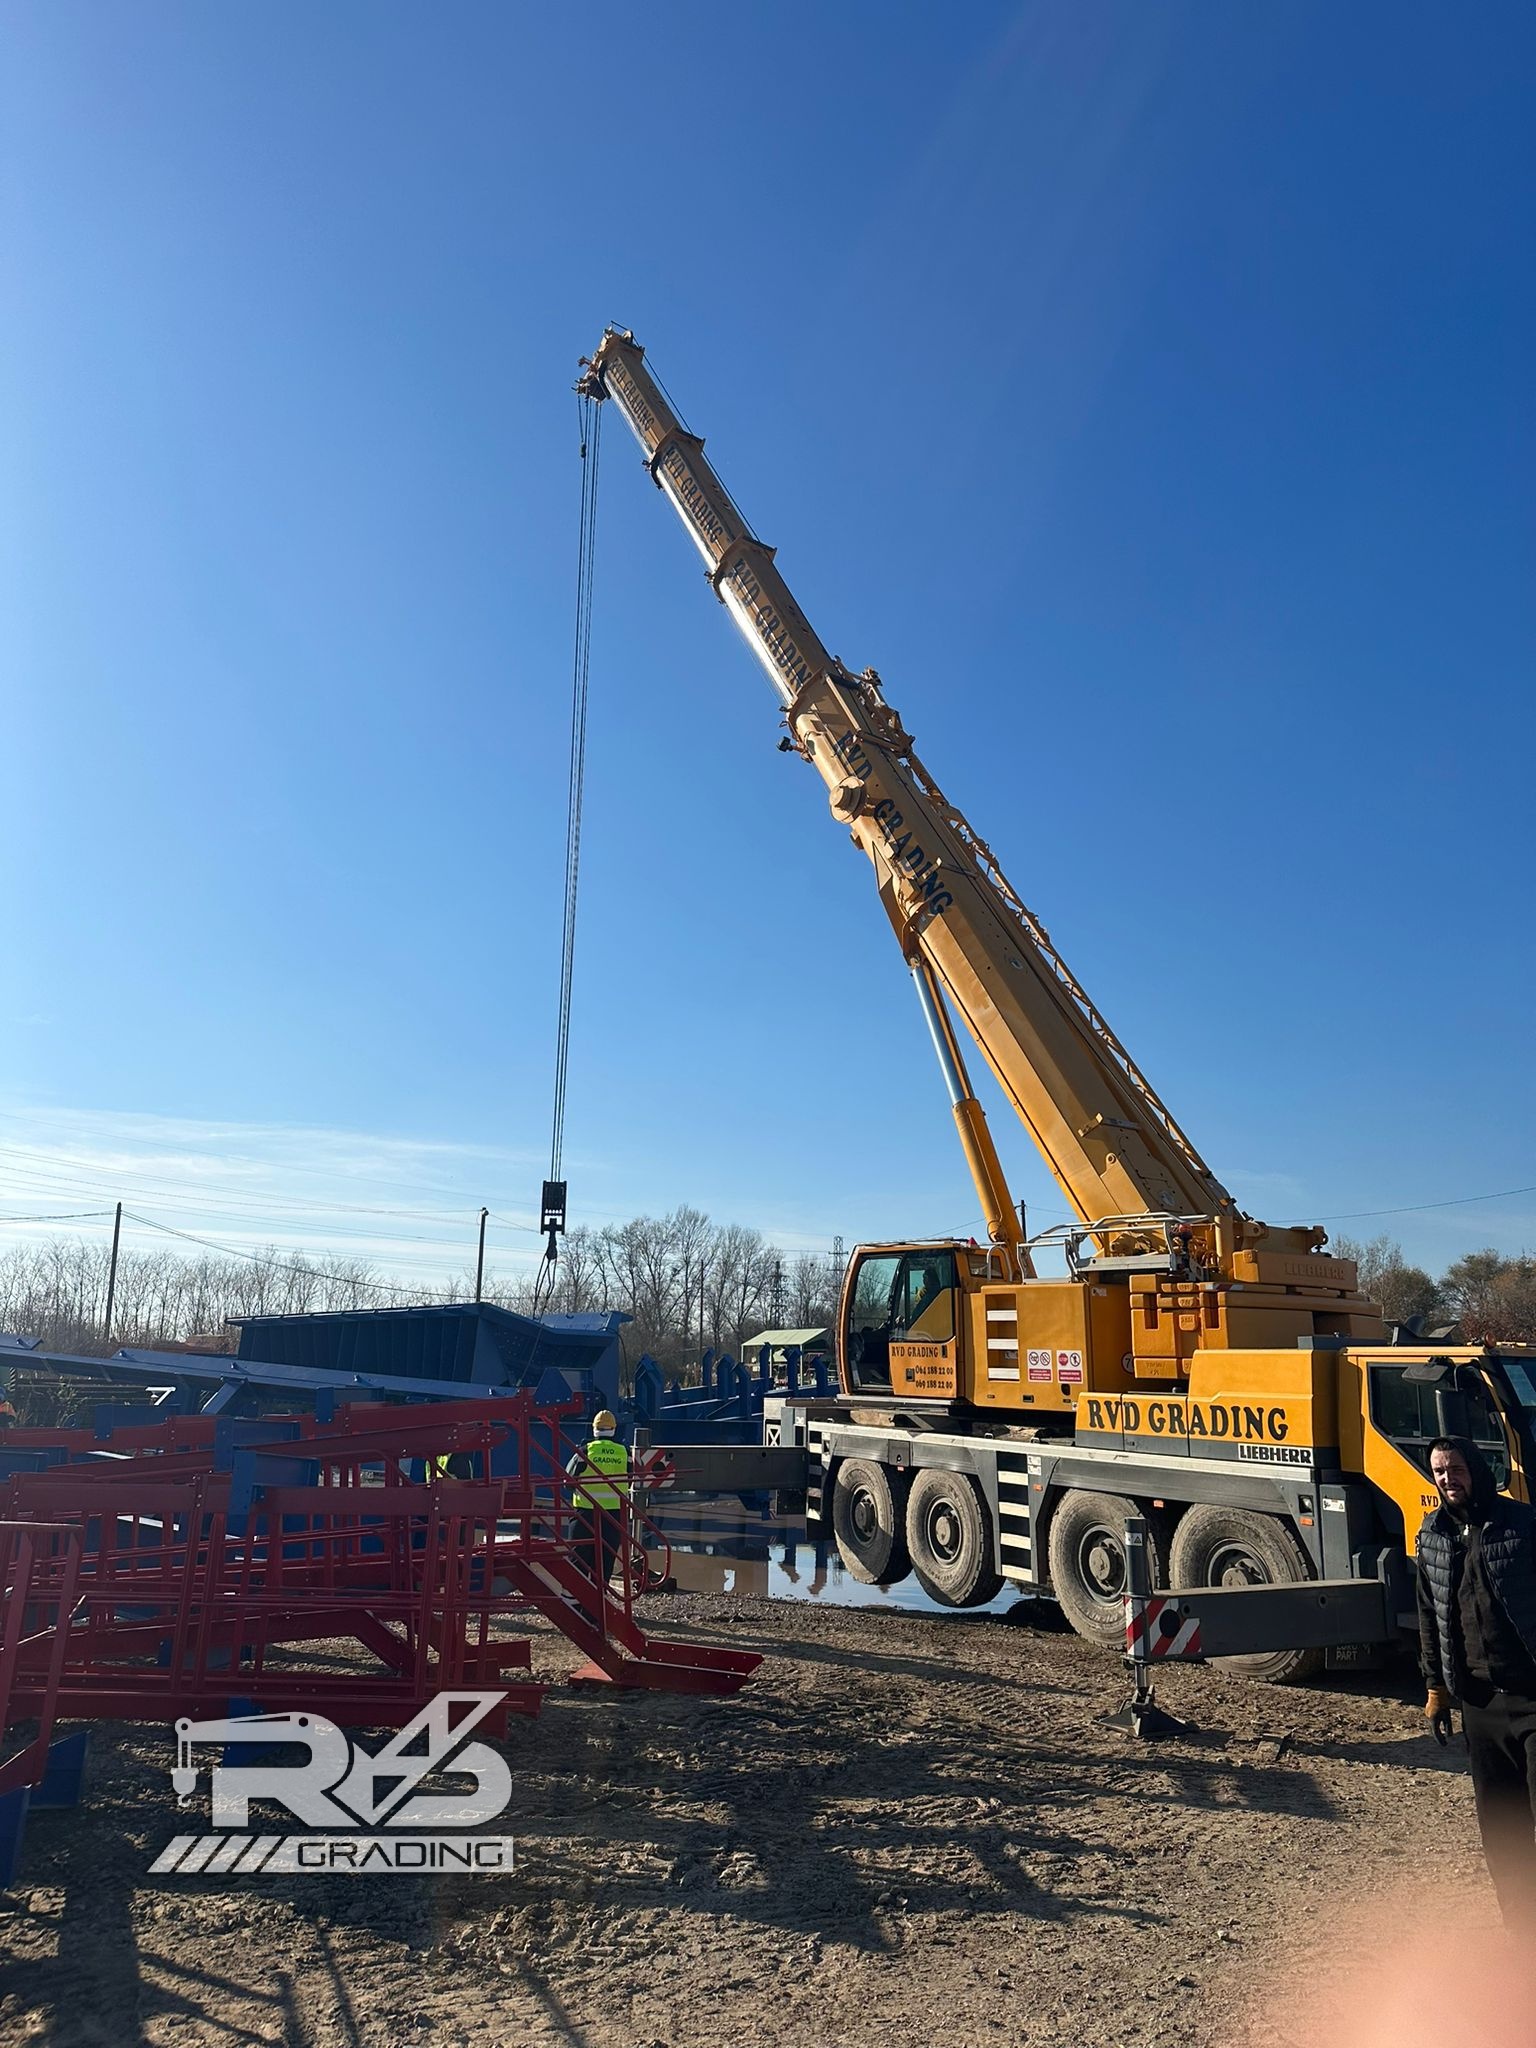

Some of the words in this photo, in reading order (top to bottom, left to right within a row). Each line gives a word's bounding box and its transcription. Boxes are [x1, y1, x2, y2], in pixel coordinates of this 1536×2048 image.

[624, 381, 654, 431] GRADING
[681, 477, 723, 543] GRADING
[729, 558, 760, 607] RVD
[756, 605, 813, 692] GRADIN
[874, 799, 954, 915] GRADING
[892, 1346, 904, 1357] RVD
[907, 1346, 938, 1358] GRADING
[939, 1367, 945, 1375] 22
[946, 1367, 953, 1375] 00
[938, 1381, 945, 1389] 22
[946, 1381, 953, 1389] 00
[1088, 1400, 1140, 1431] RVD
[1149, 1403, 1288, 1441] GRADING
[593, 1456, 622, 1465] GRADING
[1239, 1444, 1312, 1464] LIEBHERR
[1420, 1495, 1439, 1508] RVD
[1336, 1651, 1358, 1661] PART
